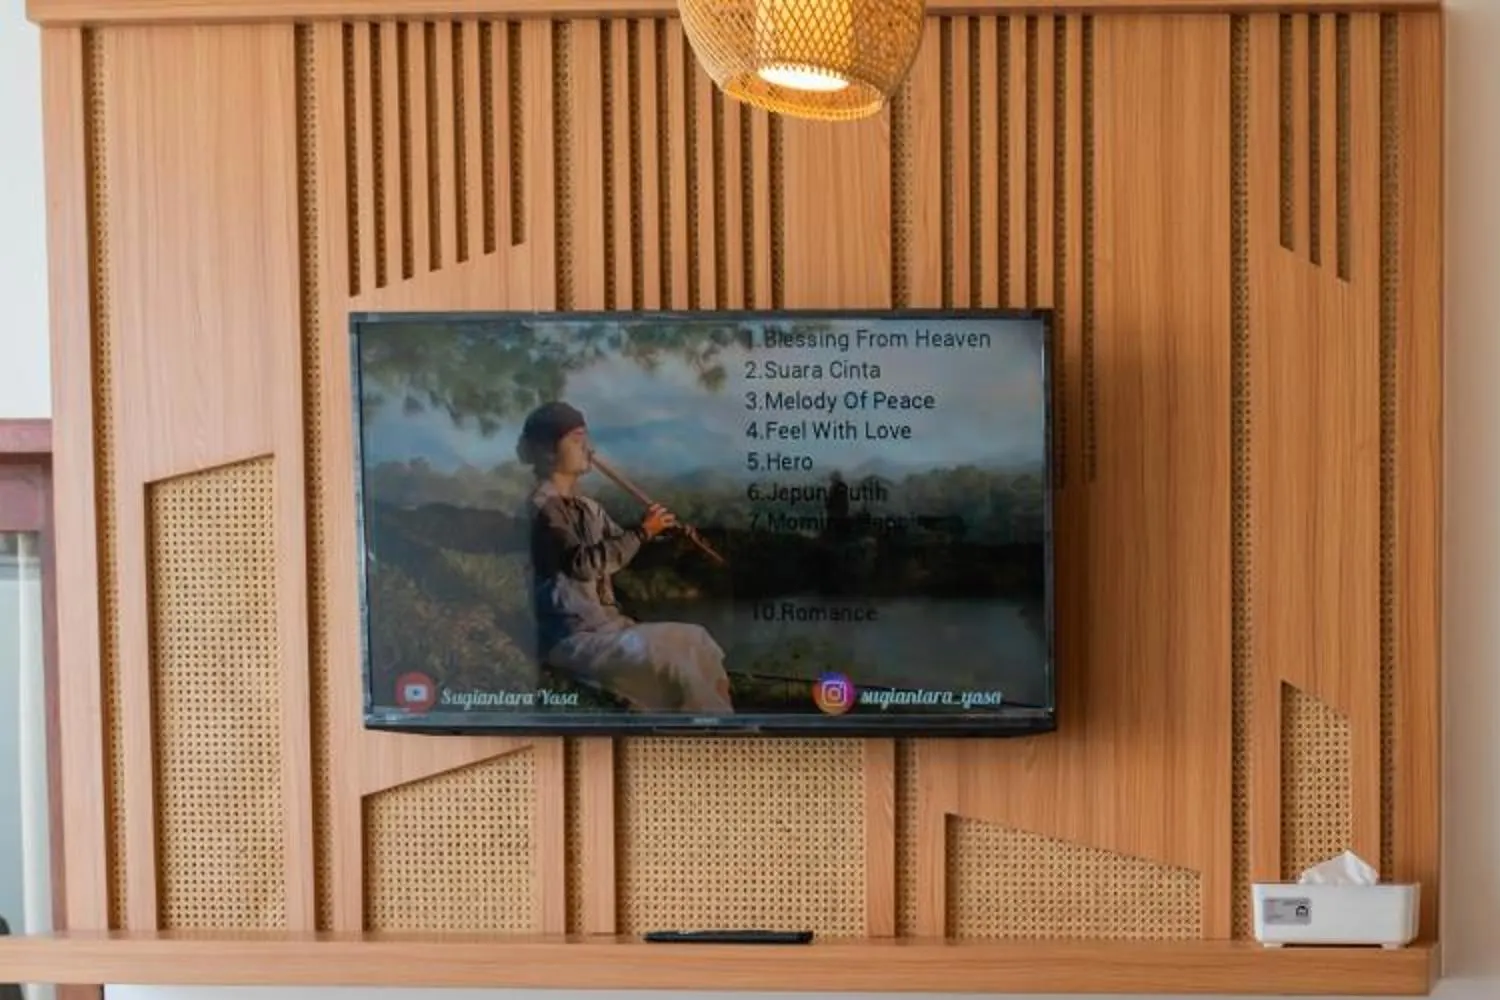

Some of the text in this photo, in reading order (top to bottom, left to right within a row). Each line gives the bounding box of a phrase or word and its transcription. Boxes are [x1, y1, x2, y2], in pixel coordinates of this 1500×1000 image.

[856, 329, 908, 347] From
[915, 329, 991, 347] Heaven
[745, 360, 881, 380] 2.Suara Cinta
[745, 391, 935, 413] 3.Melody Of Peace
[746, 421, 912, 440] 4.Feel With Love
[747, 452, 813, 472] 5.Hero
[441, 687, 580, 710] Sugiantara Yasa
